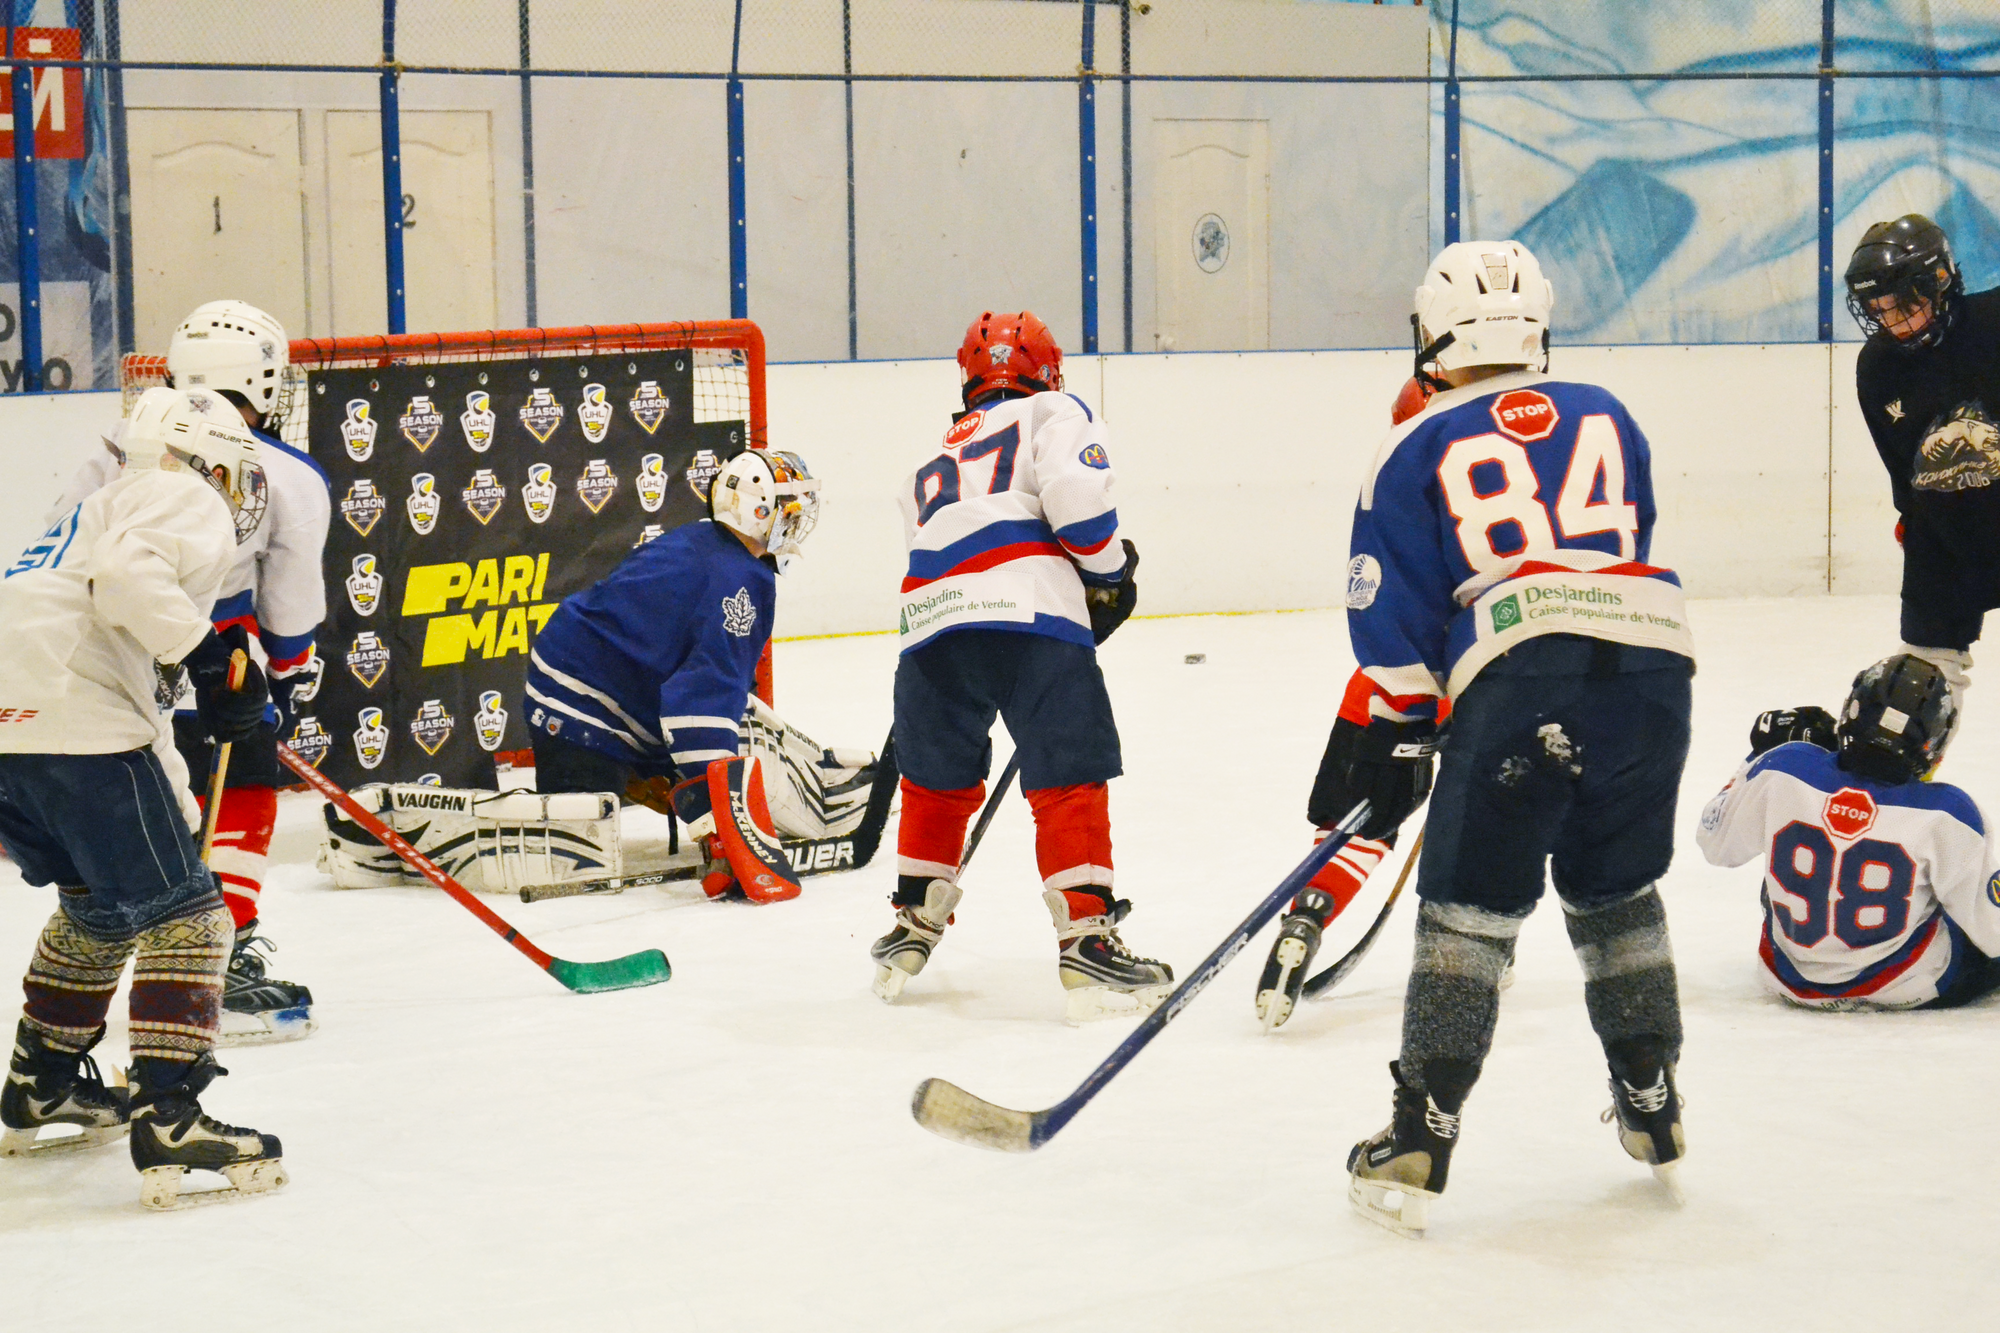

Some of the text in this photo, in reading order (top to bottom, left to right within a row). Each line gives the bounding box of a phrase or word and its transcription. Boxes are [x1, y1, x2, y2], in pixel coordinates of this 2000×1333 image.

[402, 194, 416, 229] 2
[532, 387, 550, 406] 5
[642, 381, 657, 398] 5
[412, 396, 430, 415] 5
[519, 406, 564, 420] SEASON
[629, 398, 669, 412] SEASON
[1503, 404, 1548, 421] STOP
[400, 415, 443, 429] SEASON
[469, 418, 489, 427] UHL
[584, 411, 605, 419] UHL
[350, 427, 369, 436] UHL
[948, 417, 979, 438] STOP
[208, 430, 242, 444] BAUER
[697, 450, 714, 467] 5
[589, 459, 606, 477] 5
[687, 467, 721, 481] SEASO
[914, 420, 1021, 527] 97
[475, 469, 492, 487] 5
[577, 477, 617, 491] SEASON
[643, 477, 661, 488] UHL
[354, 479, 372, 498] 5
[462, 487, 506, 502] SEASON
[530, 490, 549, 499] UHL
[1437, 414, 1639, 576] 84
[341, 498, 385, 513] SEASON
[414, 501, 433, 511] UHL
[354, 581, 375, 591] UHL
[402, 552, 549, 616] PARI
[907, 588, 963, 618] Desjardins
[1525, 585, 1622, 605] Desjardins
[911, 599, 1016, 631] Caisse populaire de Verdun
[1529, 605, 1681, 631] Caisse populaire de Verdun
[358, 632, 377, 650] 5
[347, 650, 390, 665] SEASON
[423, 700, 440, 718] 5
[301, 717, 317, 736] 5
[410, 717, 455, 734] SEASON
[481, 718, 501, 727] UHL
[287, 735, 332, 750] SEASON
[361, 736, 381, 745] UHL
[397, 792, 467, 813] VAUGHN
[1831, 804, 1869, 821] STOP
[1770, 820, 1917, 949] 98
